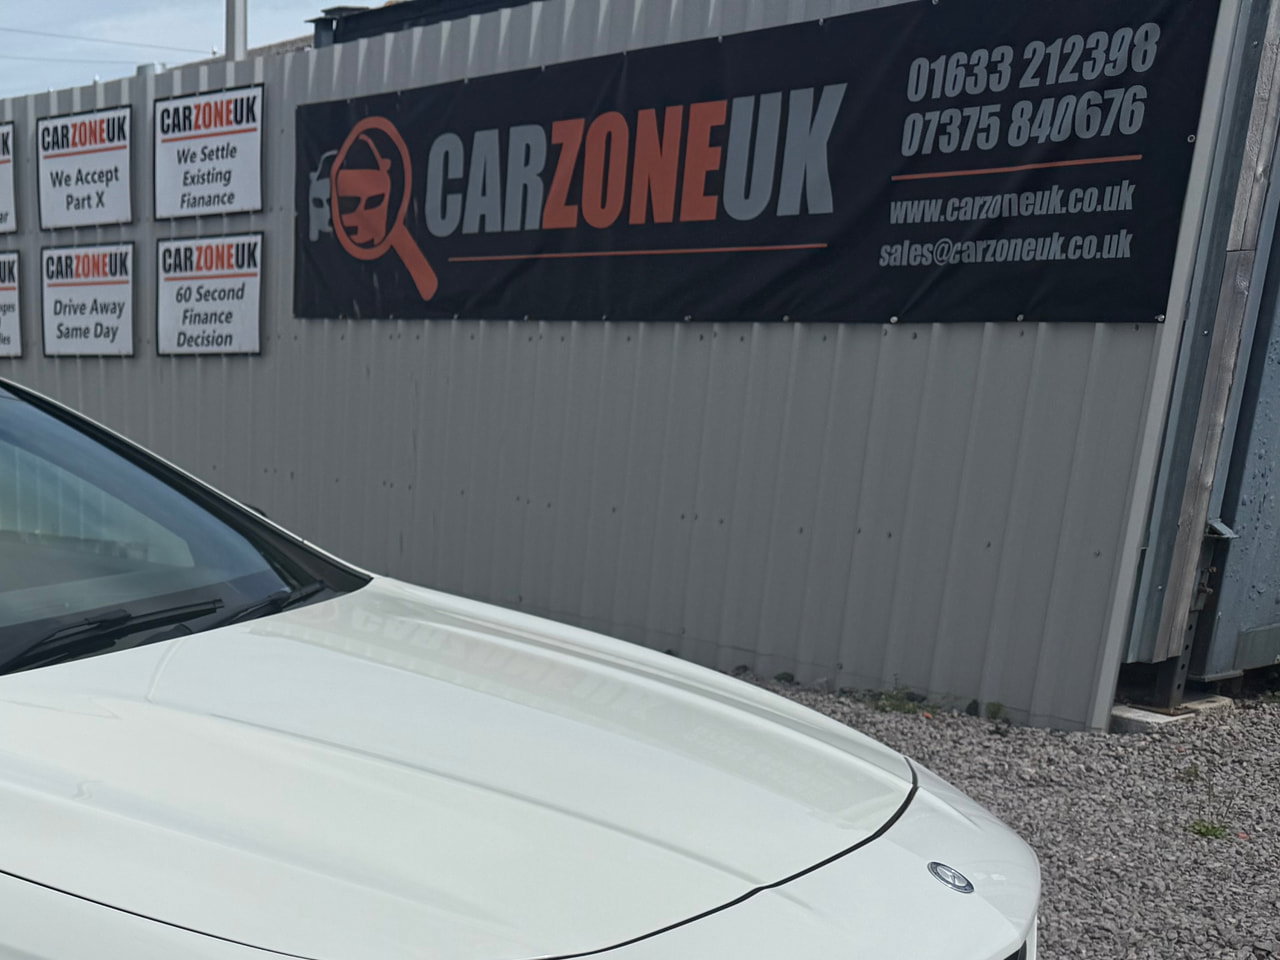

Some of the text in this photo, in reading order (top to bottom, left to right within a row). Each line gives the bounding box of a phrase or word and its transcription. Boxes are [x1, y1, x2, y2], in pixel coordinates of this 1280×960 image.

[907, 22, 1161, 102] 01633 212398
[161, 95, 256, 135] CARZONEUK
[901, 84, 1148, 157] 07375 840676
[42, 116, 126, 151] CARZONEUK
[177, 142, 237, 165] We Settle
[425, 82, 848, 238] CARZONEUK
[50, 166, 119, 188] We Accept
[183, 167, 232, 187] Existing
[66, 190, 105, 211] Part X
[180, 192, 235, 209] Fianance
[890, 179, 1136, 224] www.carzoneuk.co.uk
[162, 242, 258, 273] CARZONEUK
[879, 228, 1133, 267] sales@carzoneuk.co.uk
[46, 251, 128, 279] CARZONEUK
[176, 281, 245, 303] 60 Second
[54, 298, 125, 319] Drive Away
[182, 308, 233, 325] Finance
[56, 322, 119, 343] Same Day
[176, 330, 233, 347] Decision
